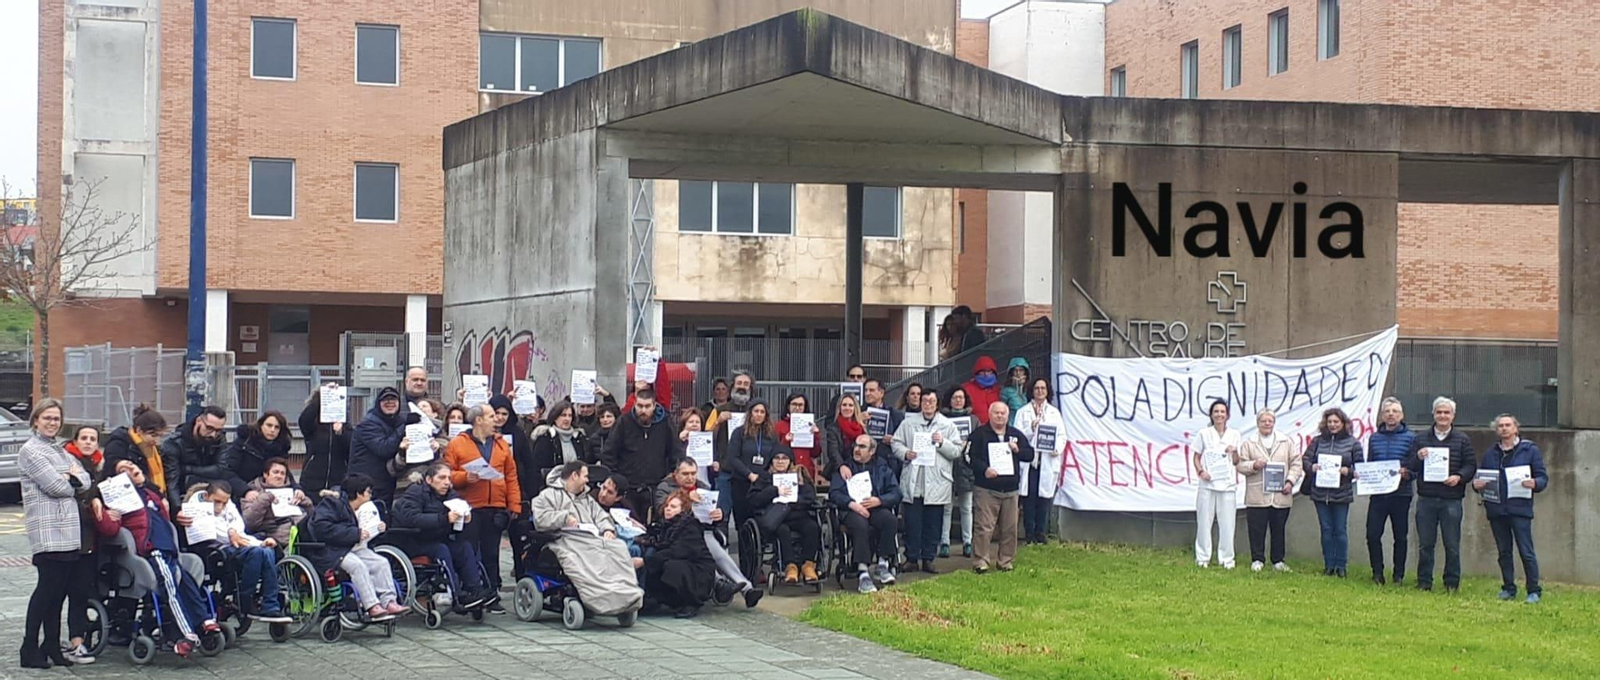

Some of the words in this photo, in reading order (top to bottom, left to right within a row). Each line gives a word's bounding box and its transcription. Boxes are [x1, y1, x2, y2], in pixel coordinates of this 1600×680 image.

[1071, 318, 1189, 342] CENTRO
[1207, 322, 1246, 346] DE
[1055, 371, 1154, 422] POLA
[1163, 359, 1361, 422] DIGNIDADE
[1058, 431, 1240, 489] ATENCI
